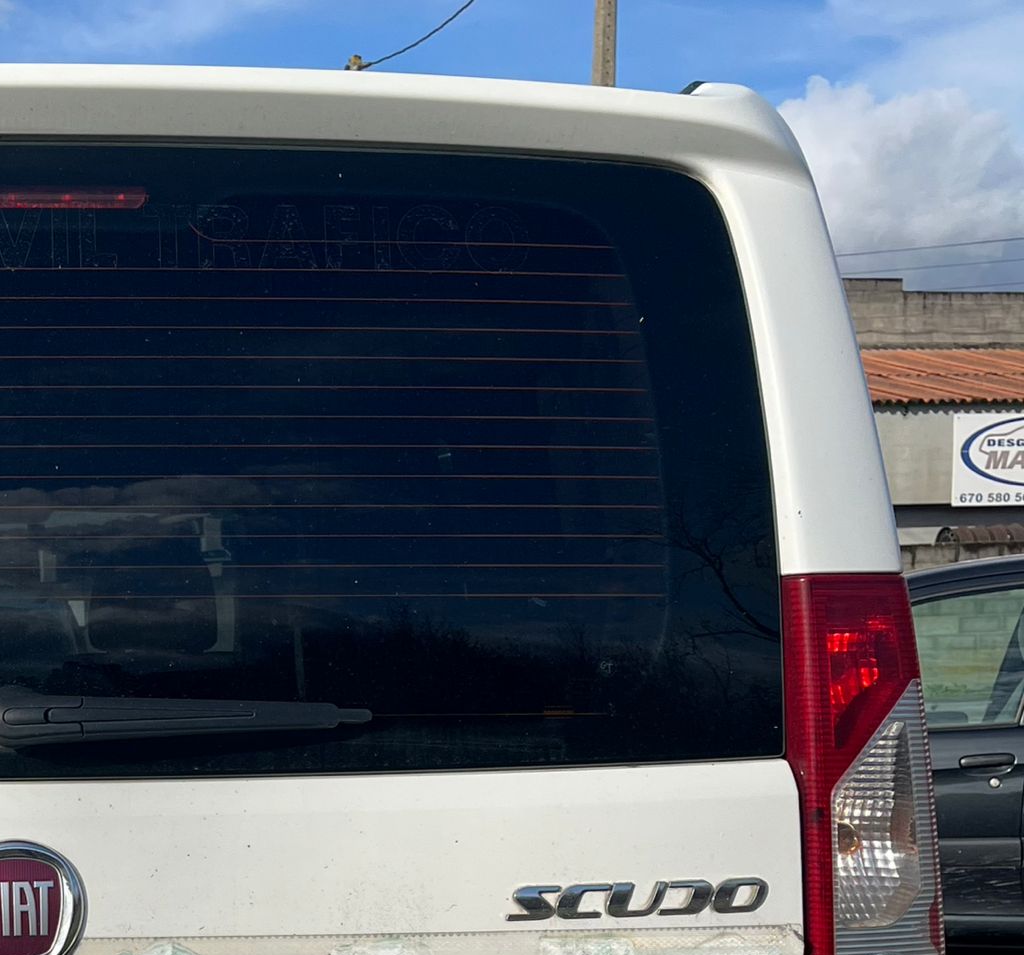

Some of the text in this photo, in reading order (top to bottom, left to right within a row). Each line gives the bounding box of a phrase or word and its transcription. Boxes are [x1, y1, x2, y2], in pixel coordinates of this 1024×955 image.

[143, 204, 529, 274] TRAFICO
[959, 493, 983, 503] 670
[987, 493, 1010, 503] 580
[505, 876, 769, 922] SCUDO
